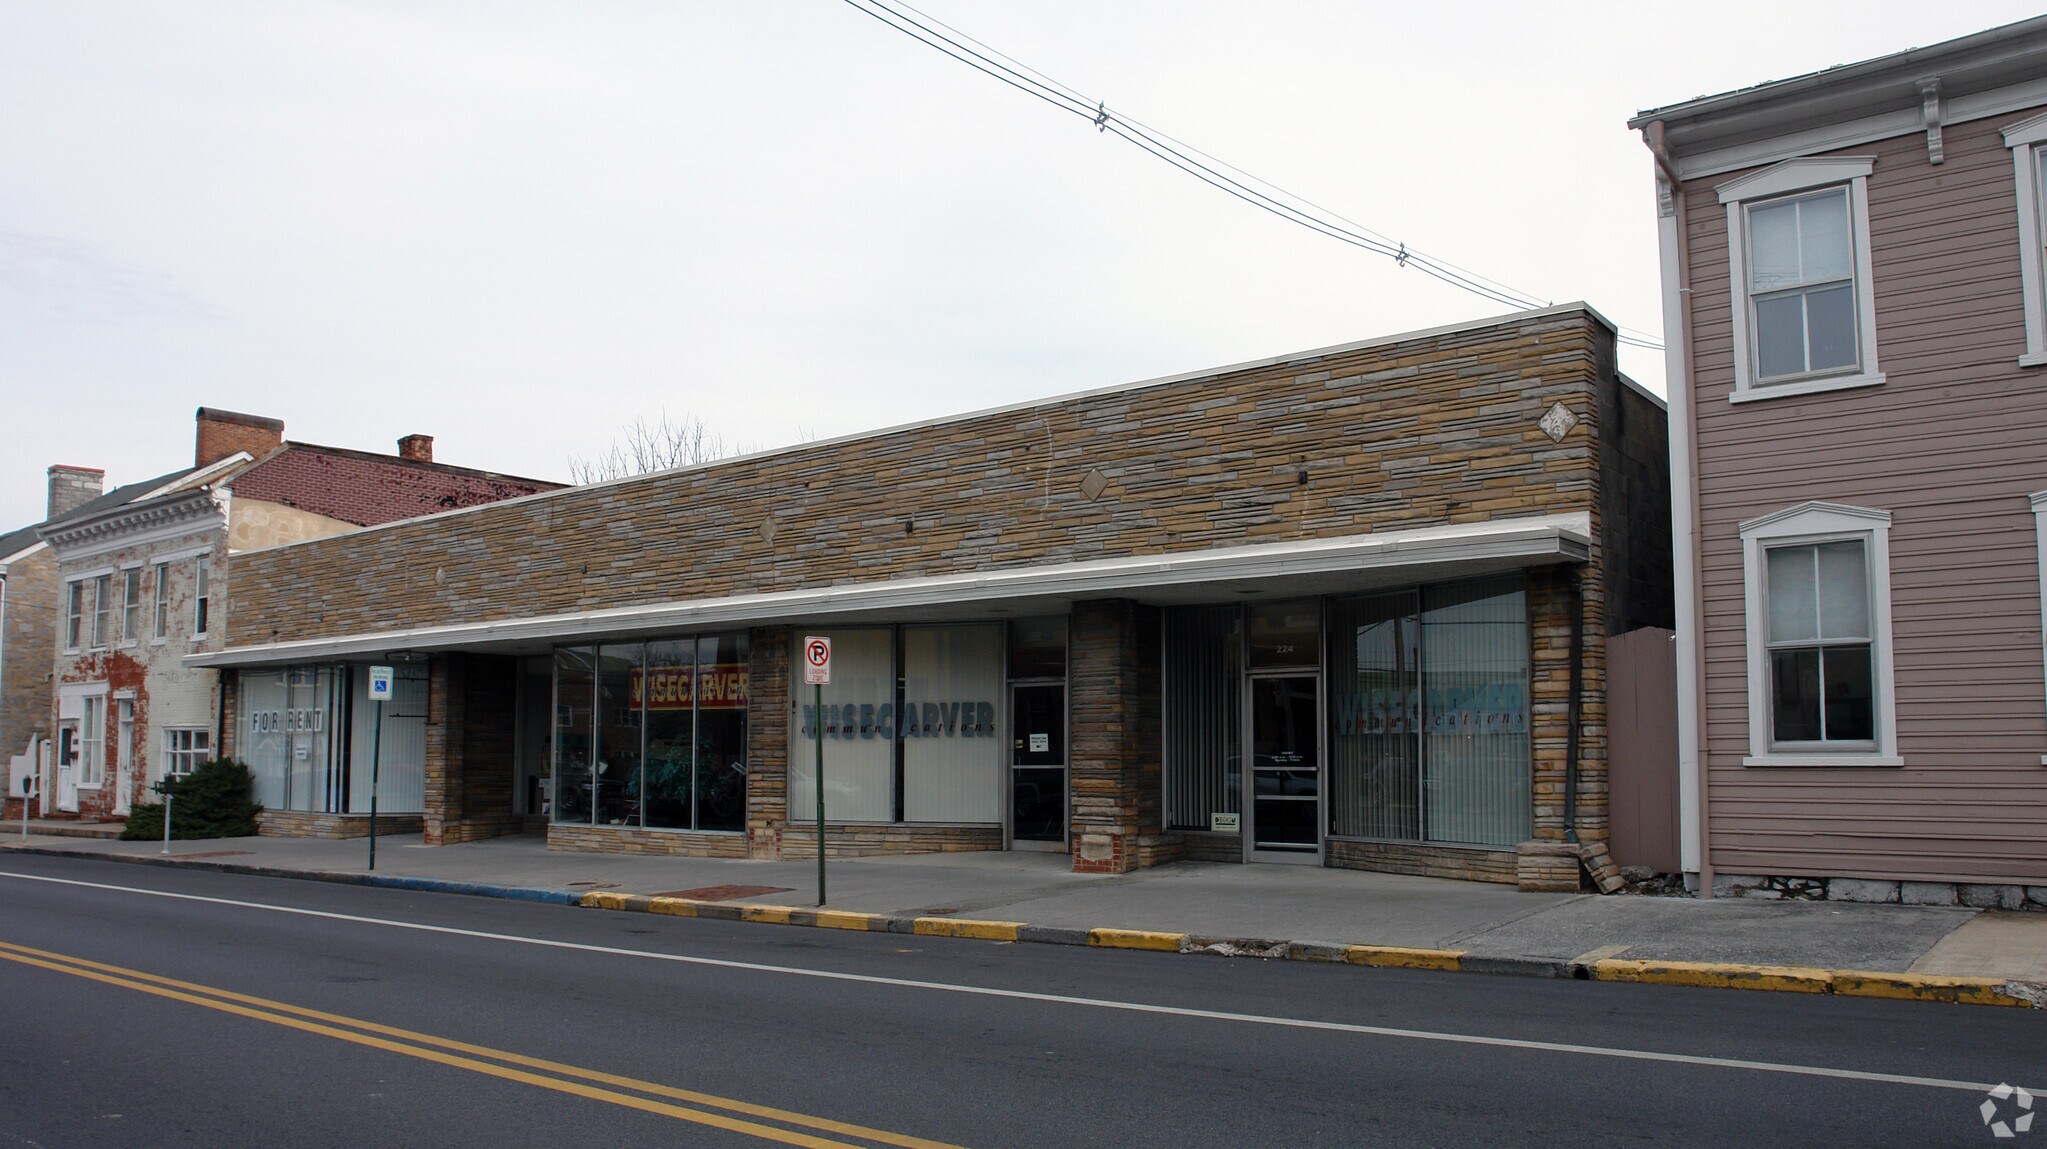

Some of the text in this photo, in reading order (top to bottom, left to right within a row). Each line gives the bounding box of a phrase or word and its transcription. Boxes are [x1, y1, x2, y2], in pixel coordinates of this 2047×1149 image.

[1276, 645, 1294, 653] 224
[252, 709, 322, 732] FOR RENT
[801, 719, 995, 735] cmmuncations
[803, 702, 994, 740] WISECARVER
